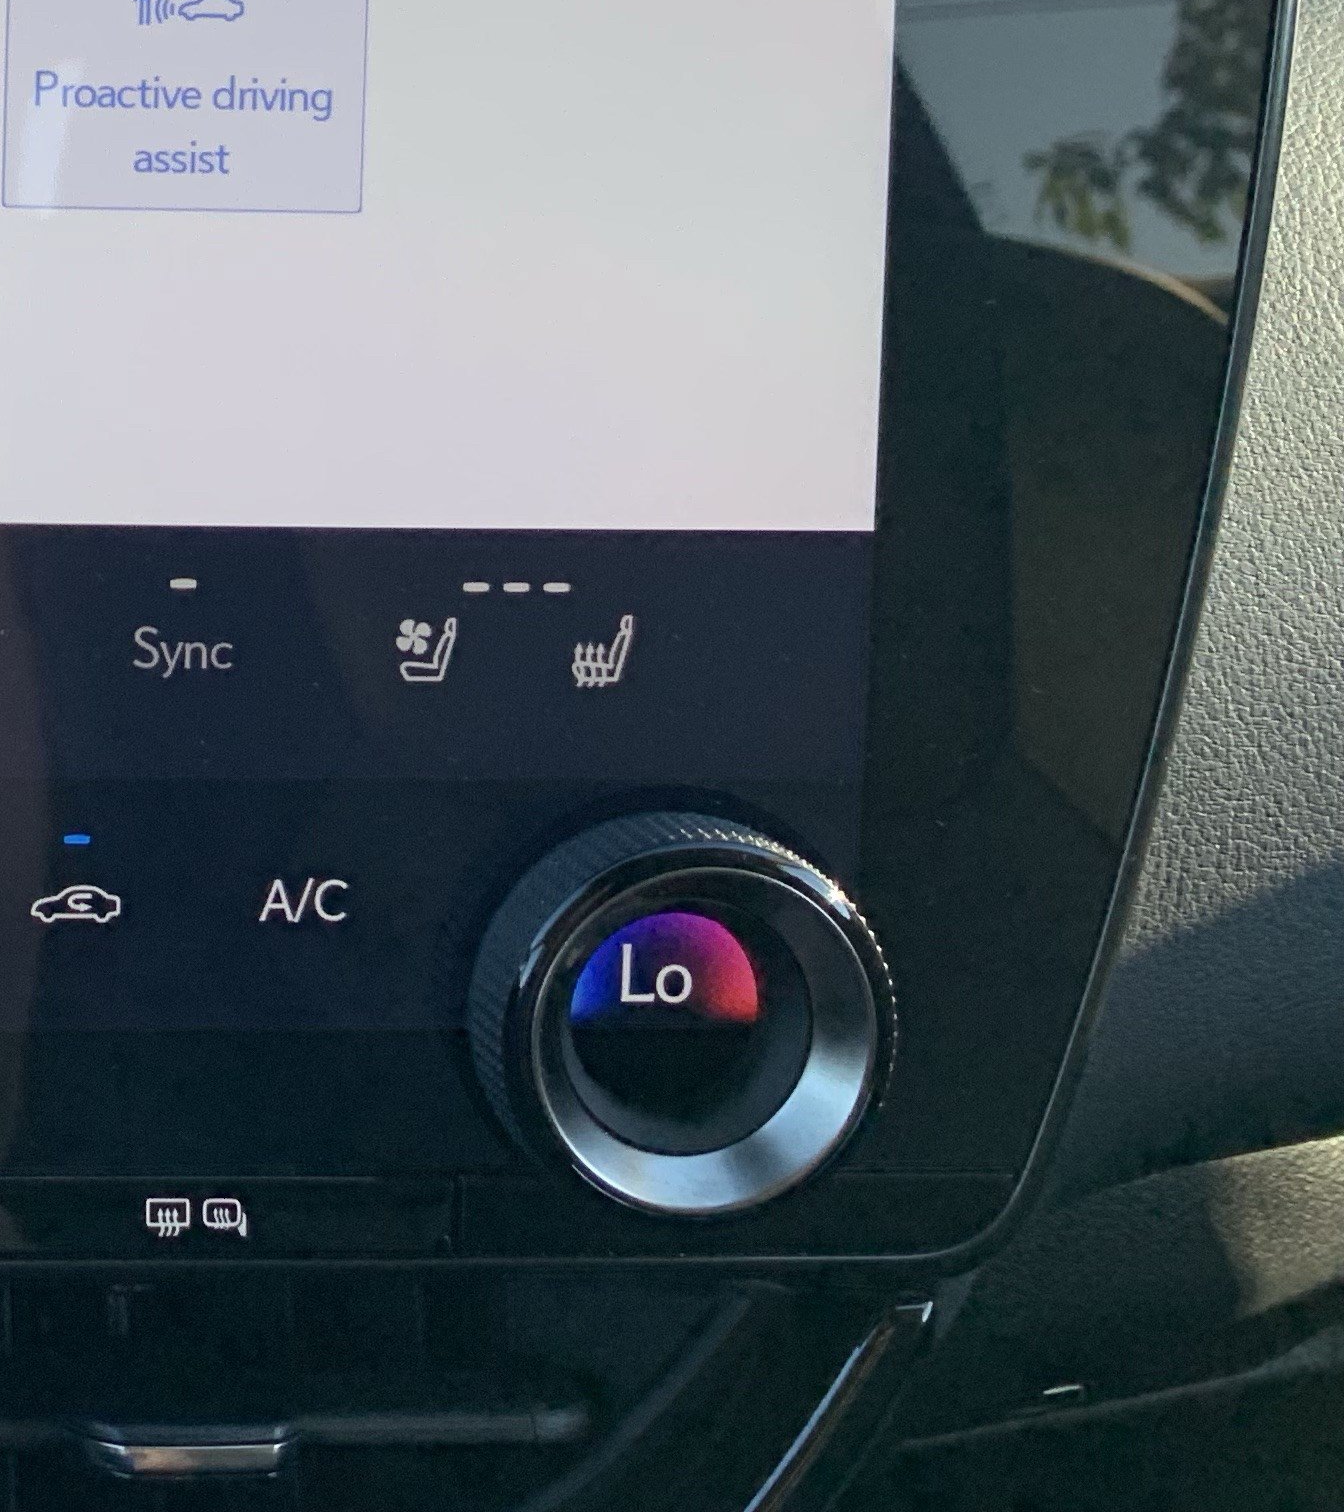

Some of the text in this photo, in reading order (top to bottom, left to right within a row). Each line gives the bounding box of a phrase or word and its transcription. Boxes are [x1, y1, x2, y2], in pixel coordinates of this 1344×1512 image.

[35, 70, 332, 121] Proactive driving
[134, 141, 229, 174] assist
[133, 626, 233, 678] Sync
[259, 878, 348, 922] A/C
[621, 944, 692, 1003] Lo
